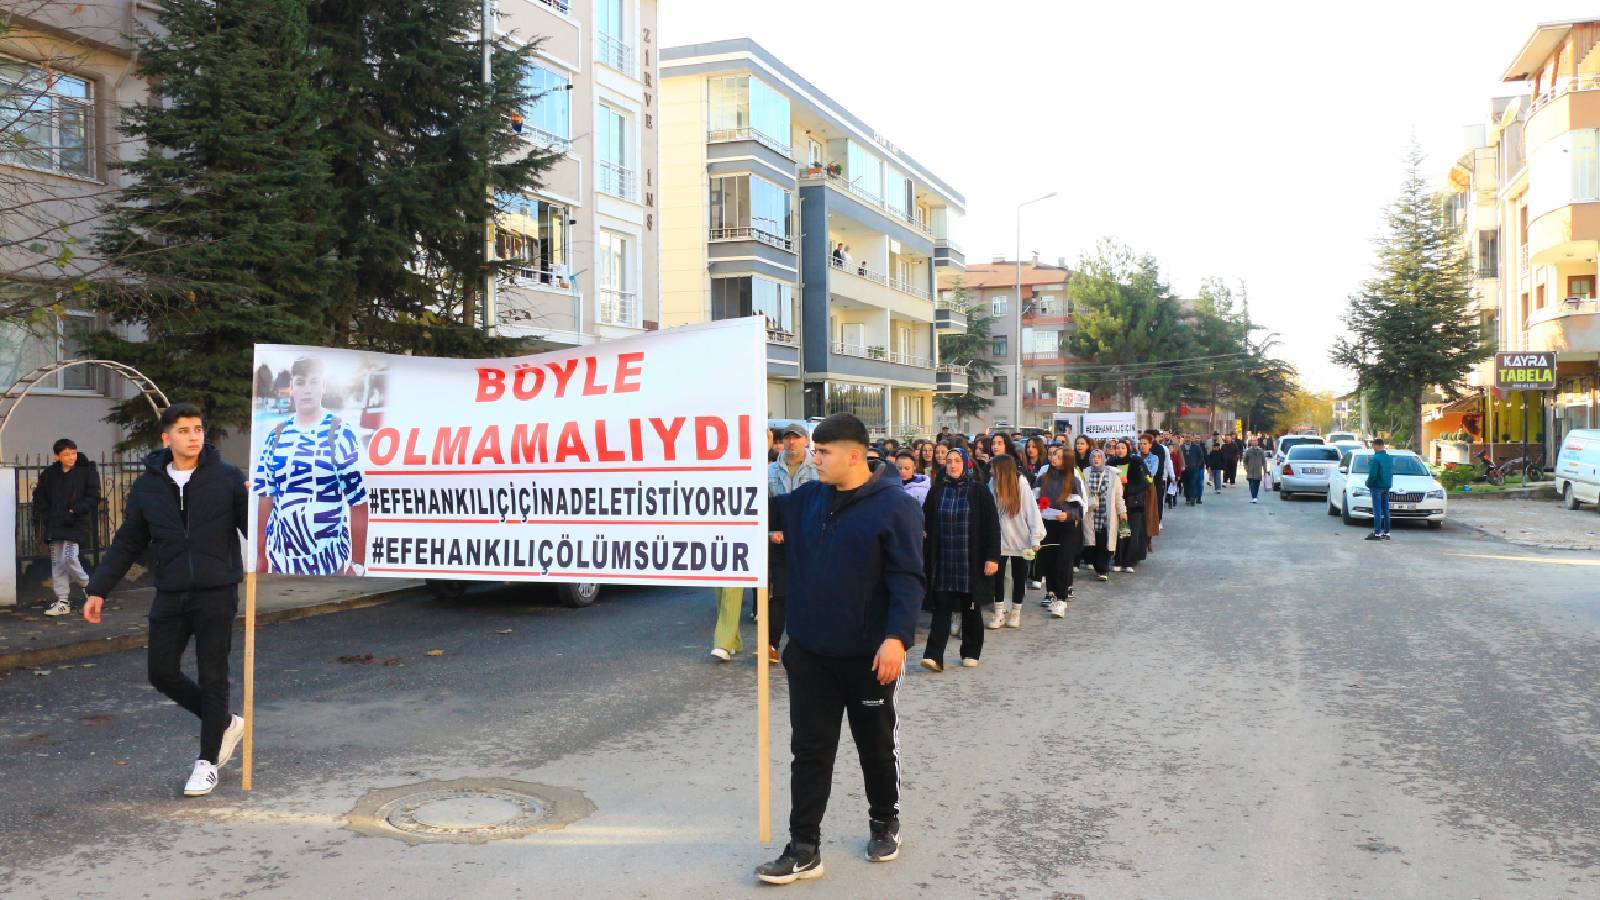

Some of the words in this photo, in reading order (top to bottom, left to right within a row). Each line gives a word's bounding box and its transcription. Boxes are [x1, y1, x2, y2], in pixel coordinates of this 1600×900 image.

[474, 351, 645, 403] BÖYLE
[1499, 368, 1553, 382] TABELA
[1503, 355, 1548, 367] KAYRA
[368, 414, 752, 466] OLMAMALIYDI
[368, 480, 759, 523] #EFEHANKILIÇİÇİNADELETİSTİYORUZ
[372, 534, 750, 576] #EFEHANKILIÇÖLÜMSÜZDÜR
